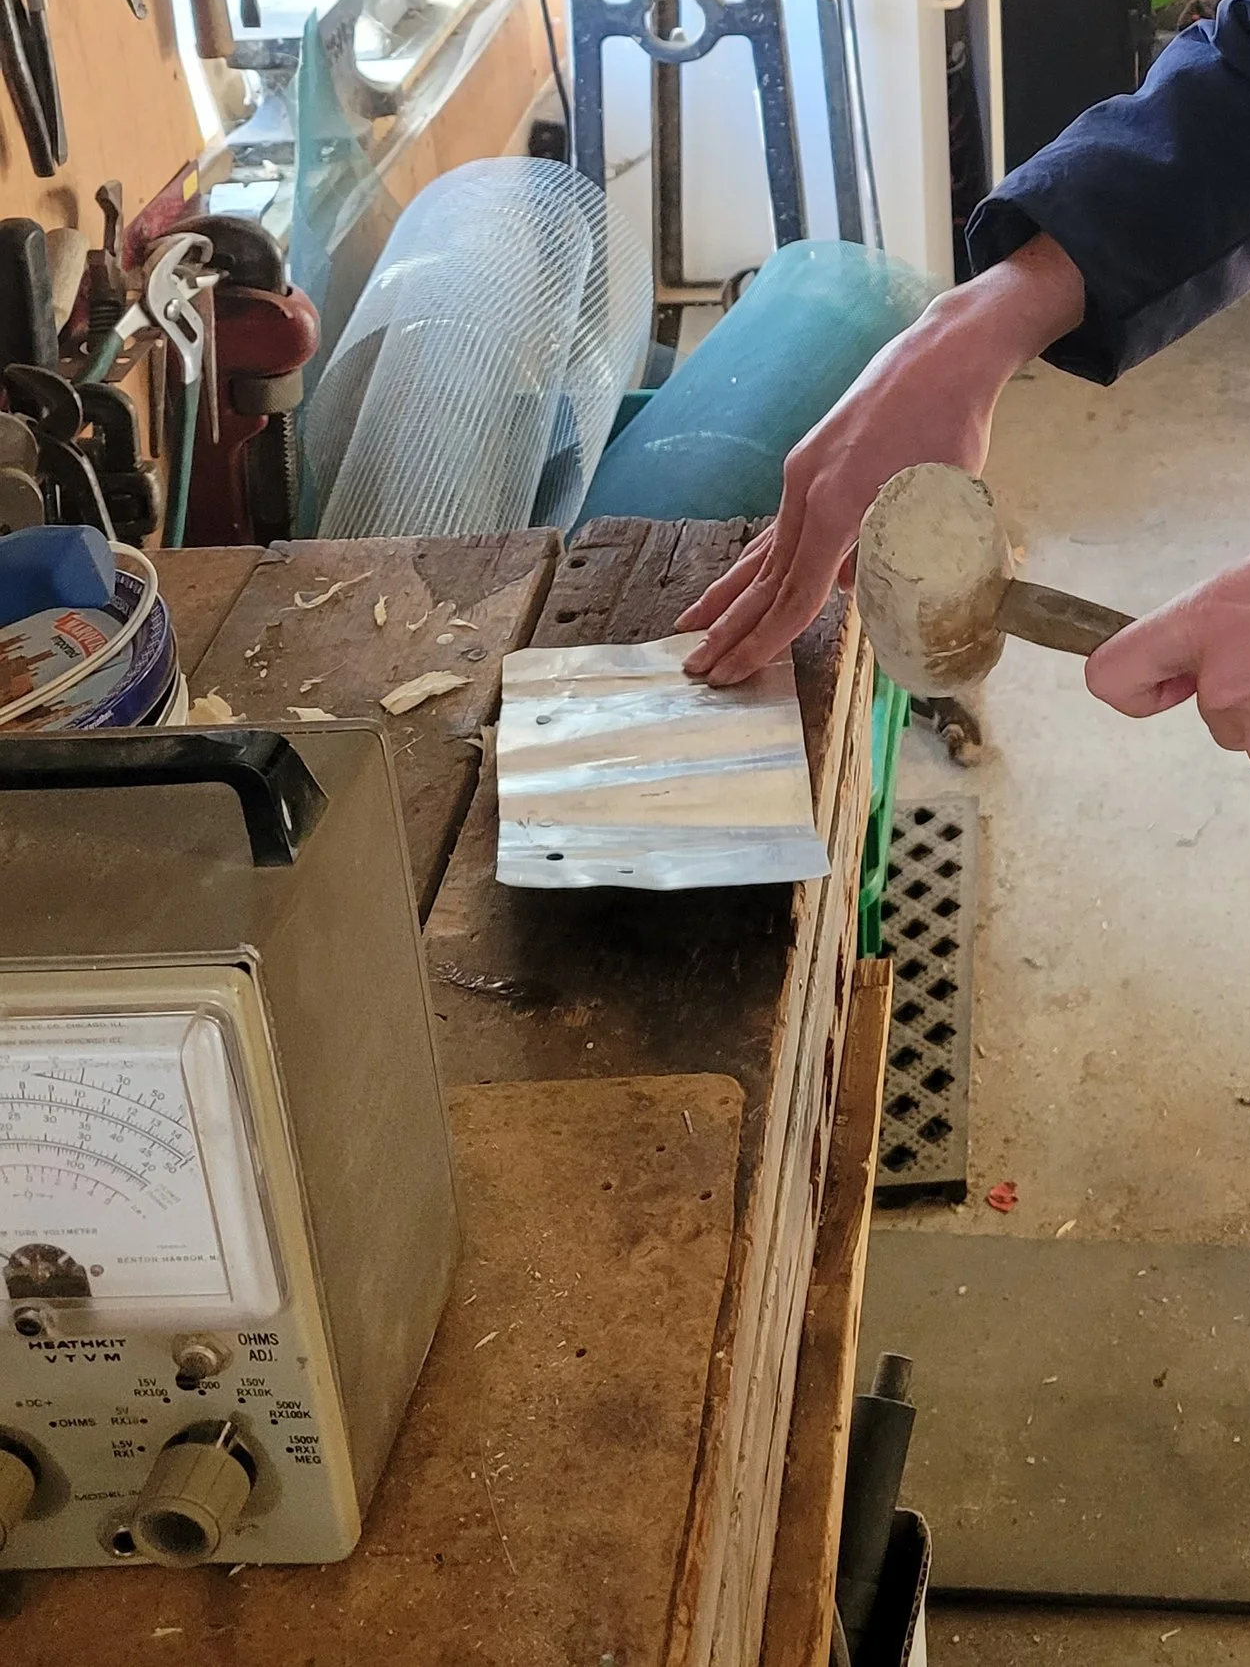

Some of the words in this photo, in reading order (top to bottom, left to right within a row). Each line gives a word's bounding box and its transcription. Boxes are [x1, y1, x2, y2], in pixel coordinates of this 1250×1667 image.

[151, 1089, 165, 1101] 50
[74, 1089, 86, 1098] 10
[126, 1107, 138, 1119] 12
[43, 1114, 57, 1124] 30
[109, 1133, 125, 1144] 40
[78, 1132, 92, 1142] 30
[28, 1338, 127, 1350] HEATHKIT
[238, 1333, 280, 1346] OHMS
[249, 1349, 278, 1362] ADJ.
[138, 1378, 157, 1386] 15V
[240, 1378, 266, 1387] 150V
[133, 1388, 169, 1397] RX100
[236, 1388, 273, 1397] RX10K
[275, 1401, 302, 1410] 500V
[115, 1406, 129, 1415] 5V
[269, 1410, 312, 1419] RX100K
[58, 1417, 97, 1427] OHMS
[289, 1435, 320, 1444] 1500V
[111, 1440, 134, 1449] 1.5V
[113, 1449, 135, 1458] RX1
[295, 1445, 317, 1454] RX1
[294, 1455, 322, 1464] MEG
